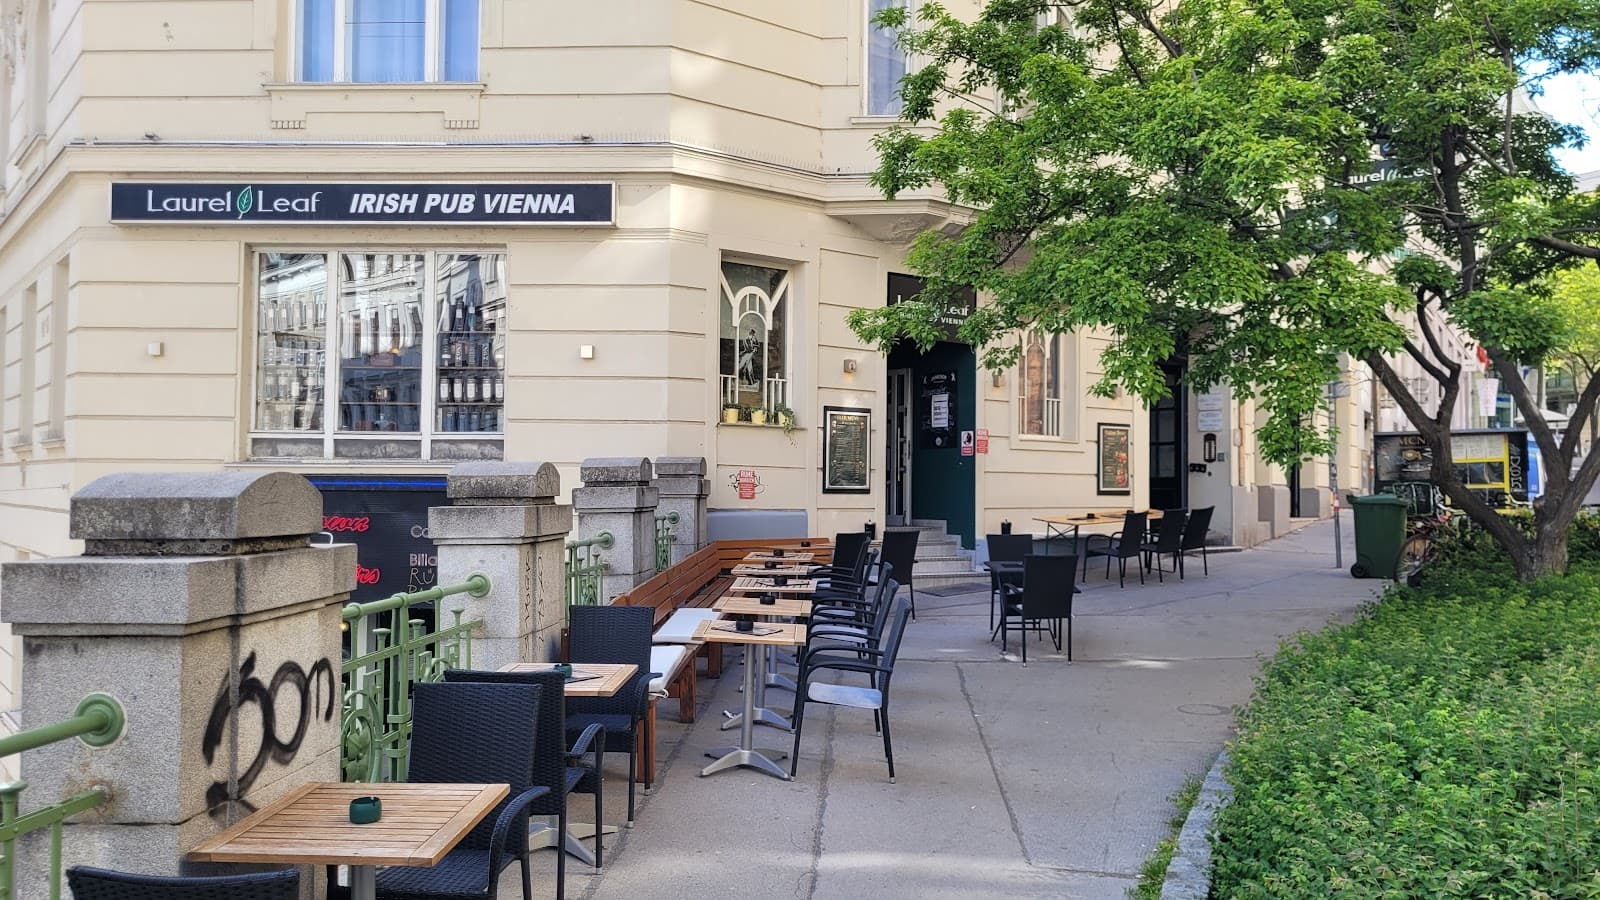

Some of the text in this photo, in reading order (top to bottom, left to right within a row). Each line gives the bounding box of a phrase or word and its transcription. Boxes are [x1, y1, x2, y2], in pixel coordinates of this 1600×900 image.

[1347, 168, 1385, 185] aurel
[147, 189, 323, 212] Laurel Leaf
[350, 193, 575, 213] IRISH PUB VIENNA
[941, 316, 965, 325] VIENN
